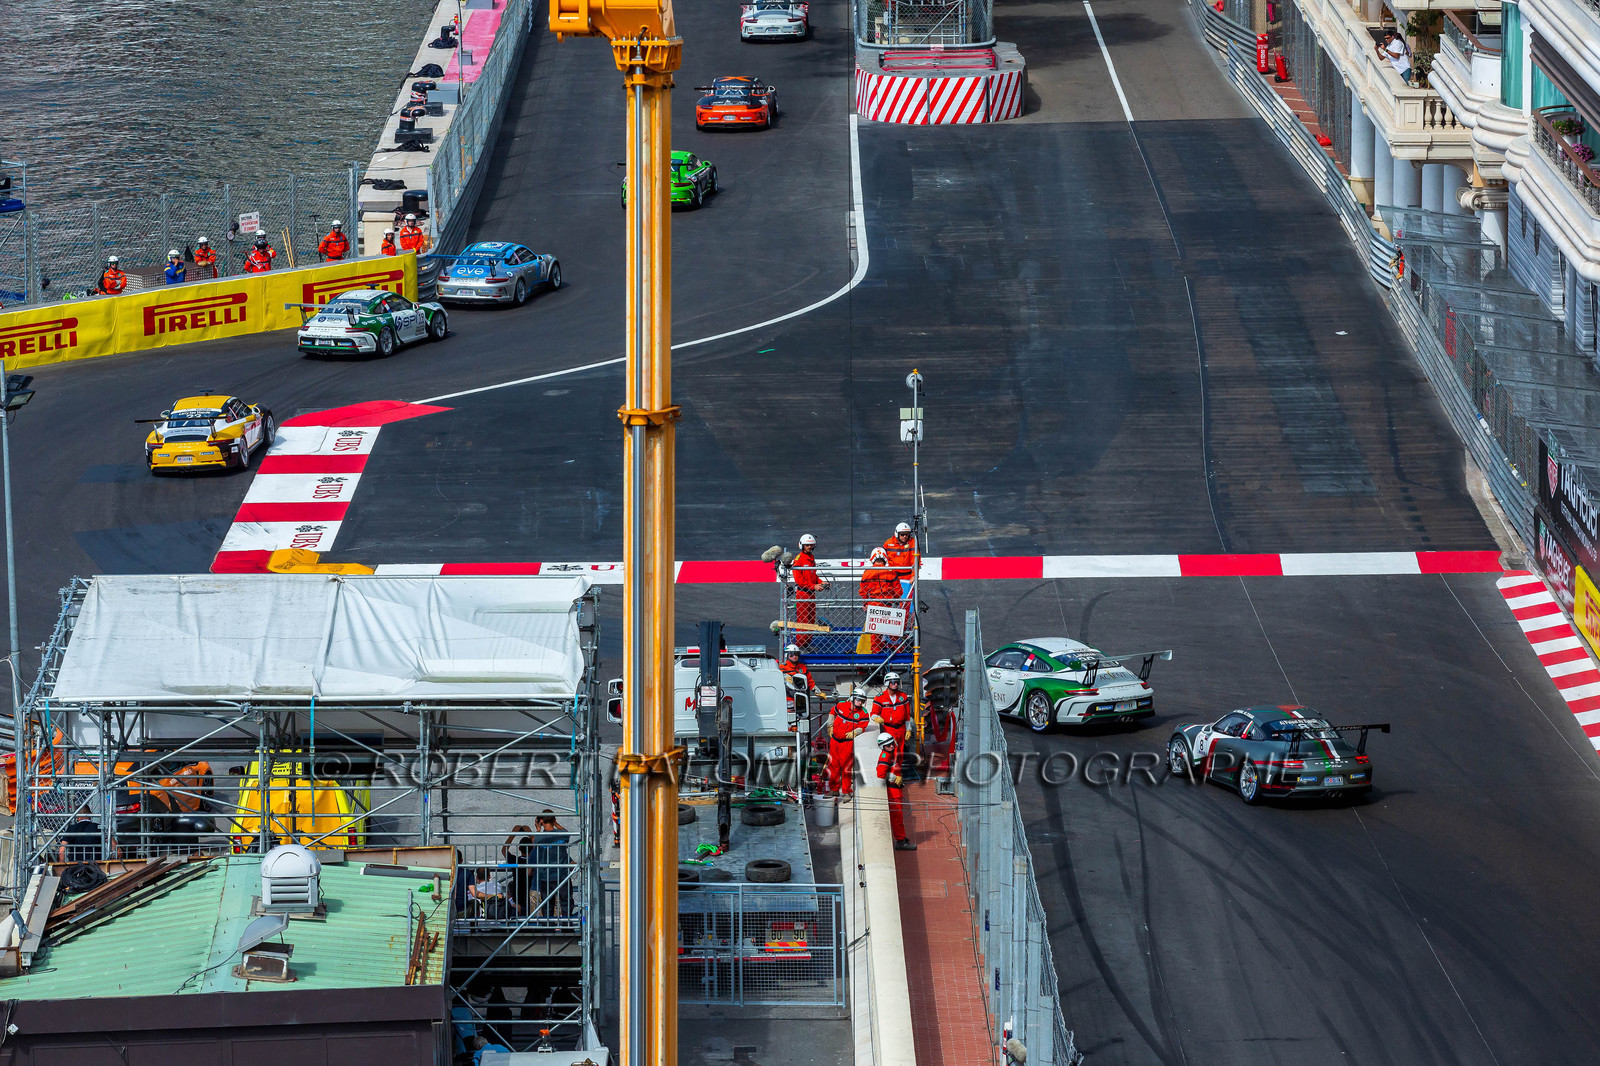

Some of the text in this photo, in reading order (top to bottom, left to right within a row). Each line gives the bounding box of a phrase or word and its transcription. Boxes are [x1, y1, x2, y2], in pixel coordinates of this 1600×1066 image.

[457, 267, 484, 275] eve
[143, 292, 248, 336] PIRELLI
[403, 314, 418, 327] SPI
[0, 317, 78, 358] RELLI
[333, 436, 363, 451] UBS
[312, 483, 344, 499] UBS
[290, 532, 323, 550] UBS
[868, 623, 877, 631] 10
[869, 617, 901, 626] INTERVENTION
[1199, 739, 1204, 751] 8
